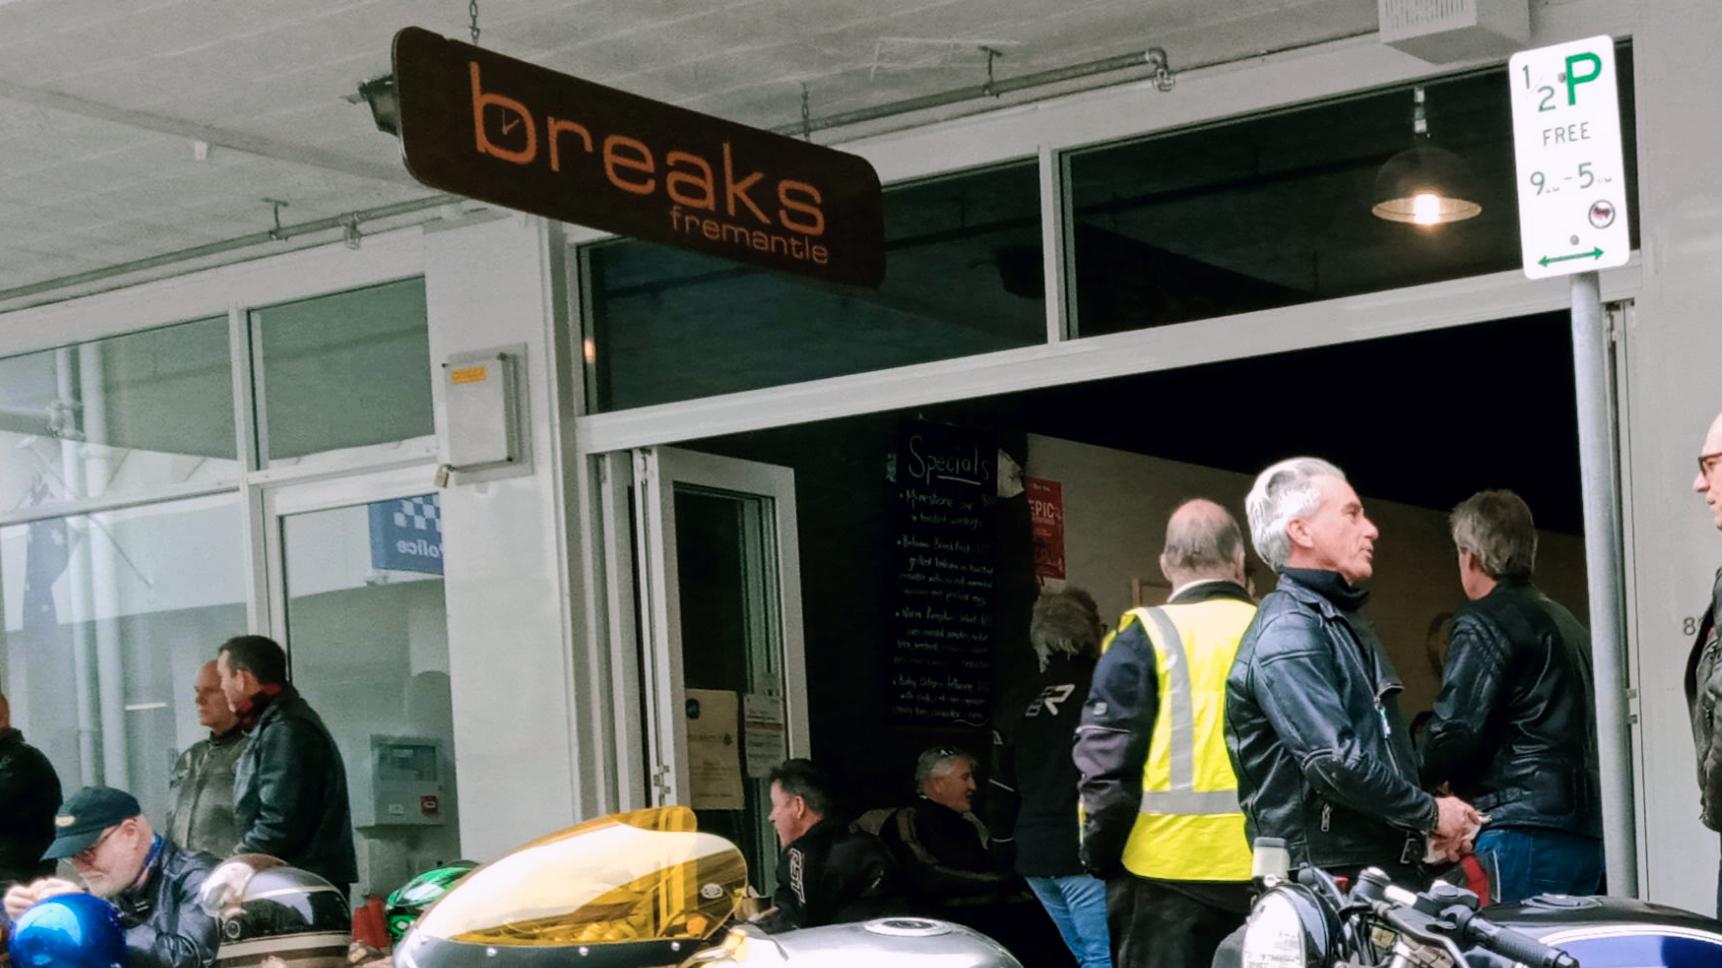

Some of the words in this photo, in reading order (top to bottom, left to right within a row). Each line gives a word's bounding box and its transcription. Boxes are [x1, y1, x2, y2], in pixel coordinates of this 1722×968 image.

[469, 60, 826, 236] breaks
[1543, 121, 1591, 147] FREE
[669, 205, 829, 265] fremantle
[907, 434, 990, 486] Specials
[787, 847, 808, 905] RST
